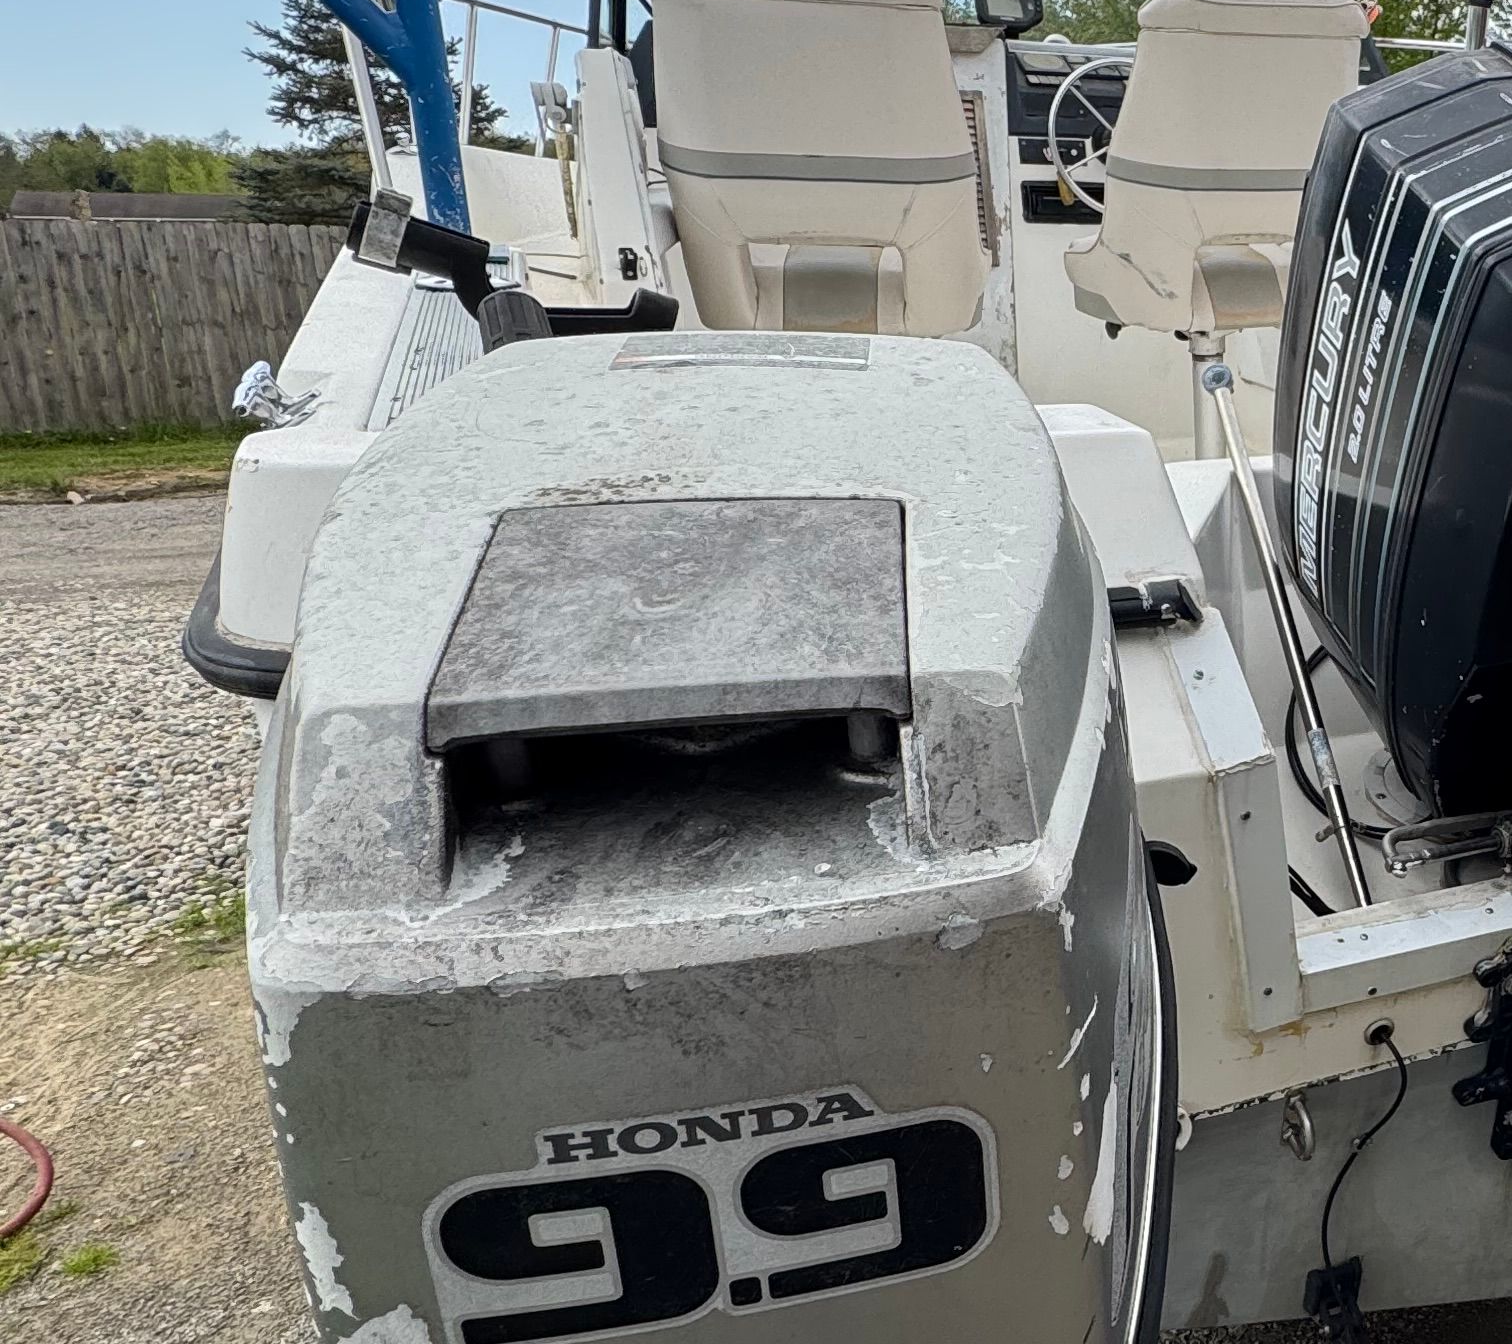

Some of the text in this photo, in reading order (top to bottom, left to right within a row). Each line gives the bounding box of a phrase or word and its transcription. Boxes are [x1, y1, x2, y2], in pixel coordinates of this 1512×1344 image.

[1358, 289, 1393, 406] LITRE
[1300, 217, 1360, 599] MERCURY
[543, 1092, 874, 1165] HONDA
